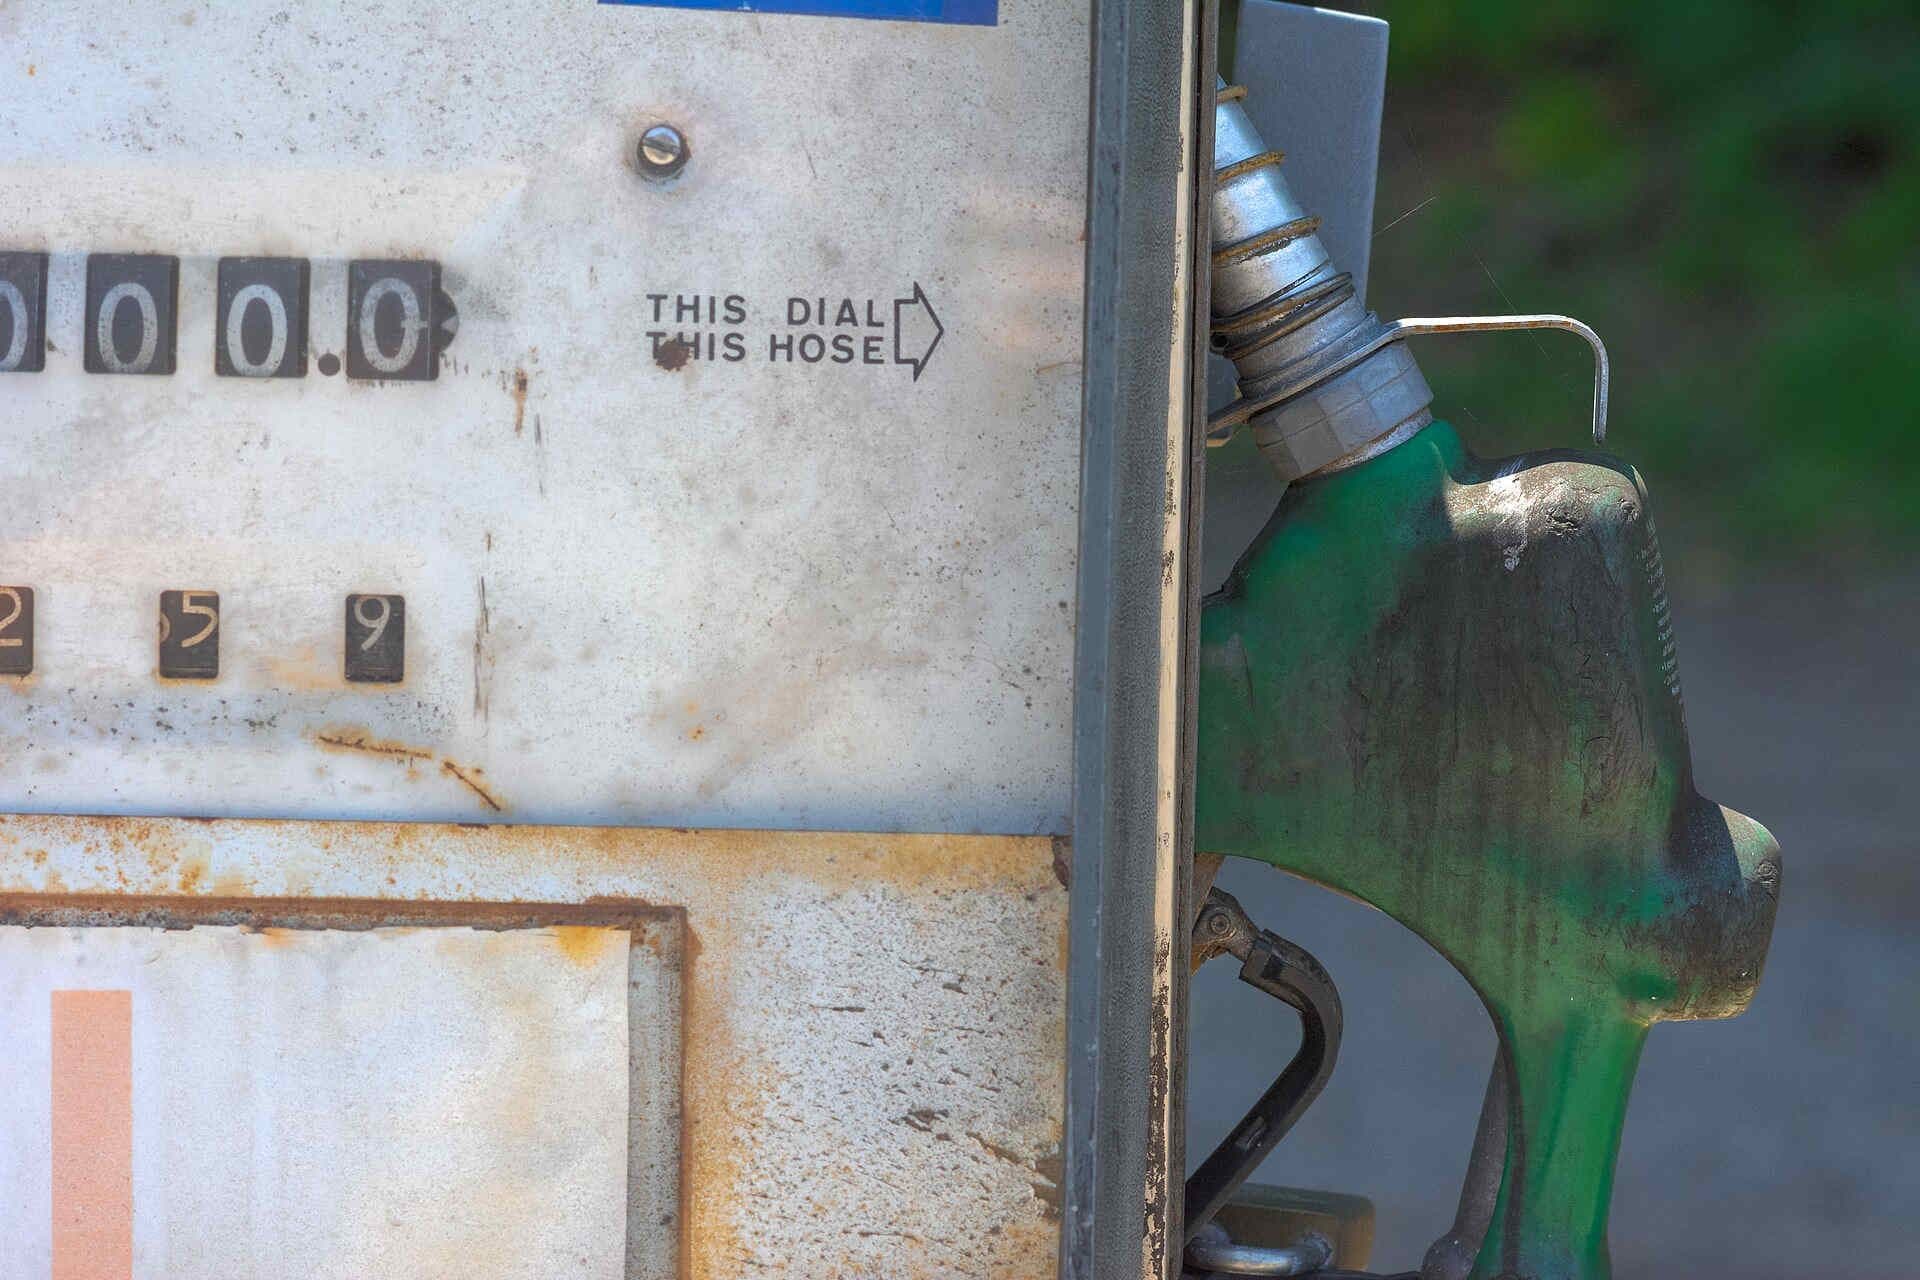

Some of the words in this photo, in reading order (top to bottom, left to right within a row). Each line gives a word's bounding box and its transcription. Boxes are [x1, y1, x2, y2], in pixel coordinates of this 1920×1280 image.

[645, 293, 747, 325] THIS
[786, 297, 885, 327] DIAL
[645, 331, 747, 362] THIS
[769, 333, 885, 364] HOSE
[354, 596, 391, 651] 9
